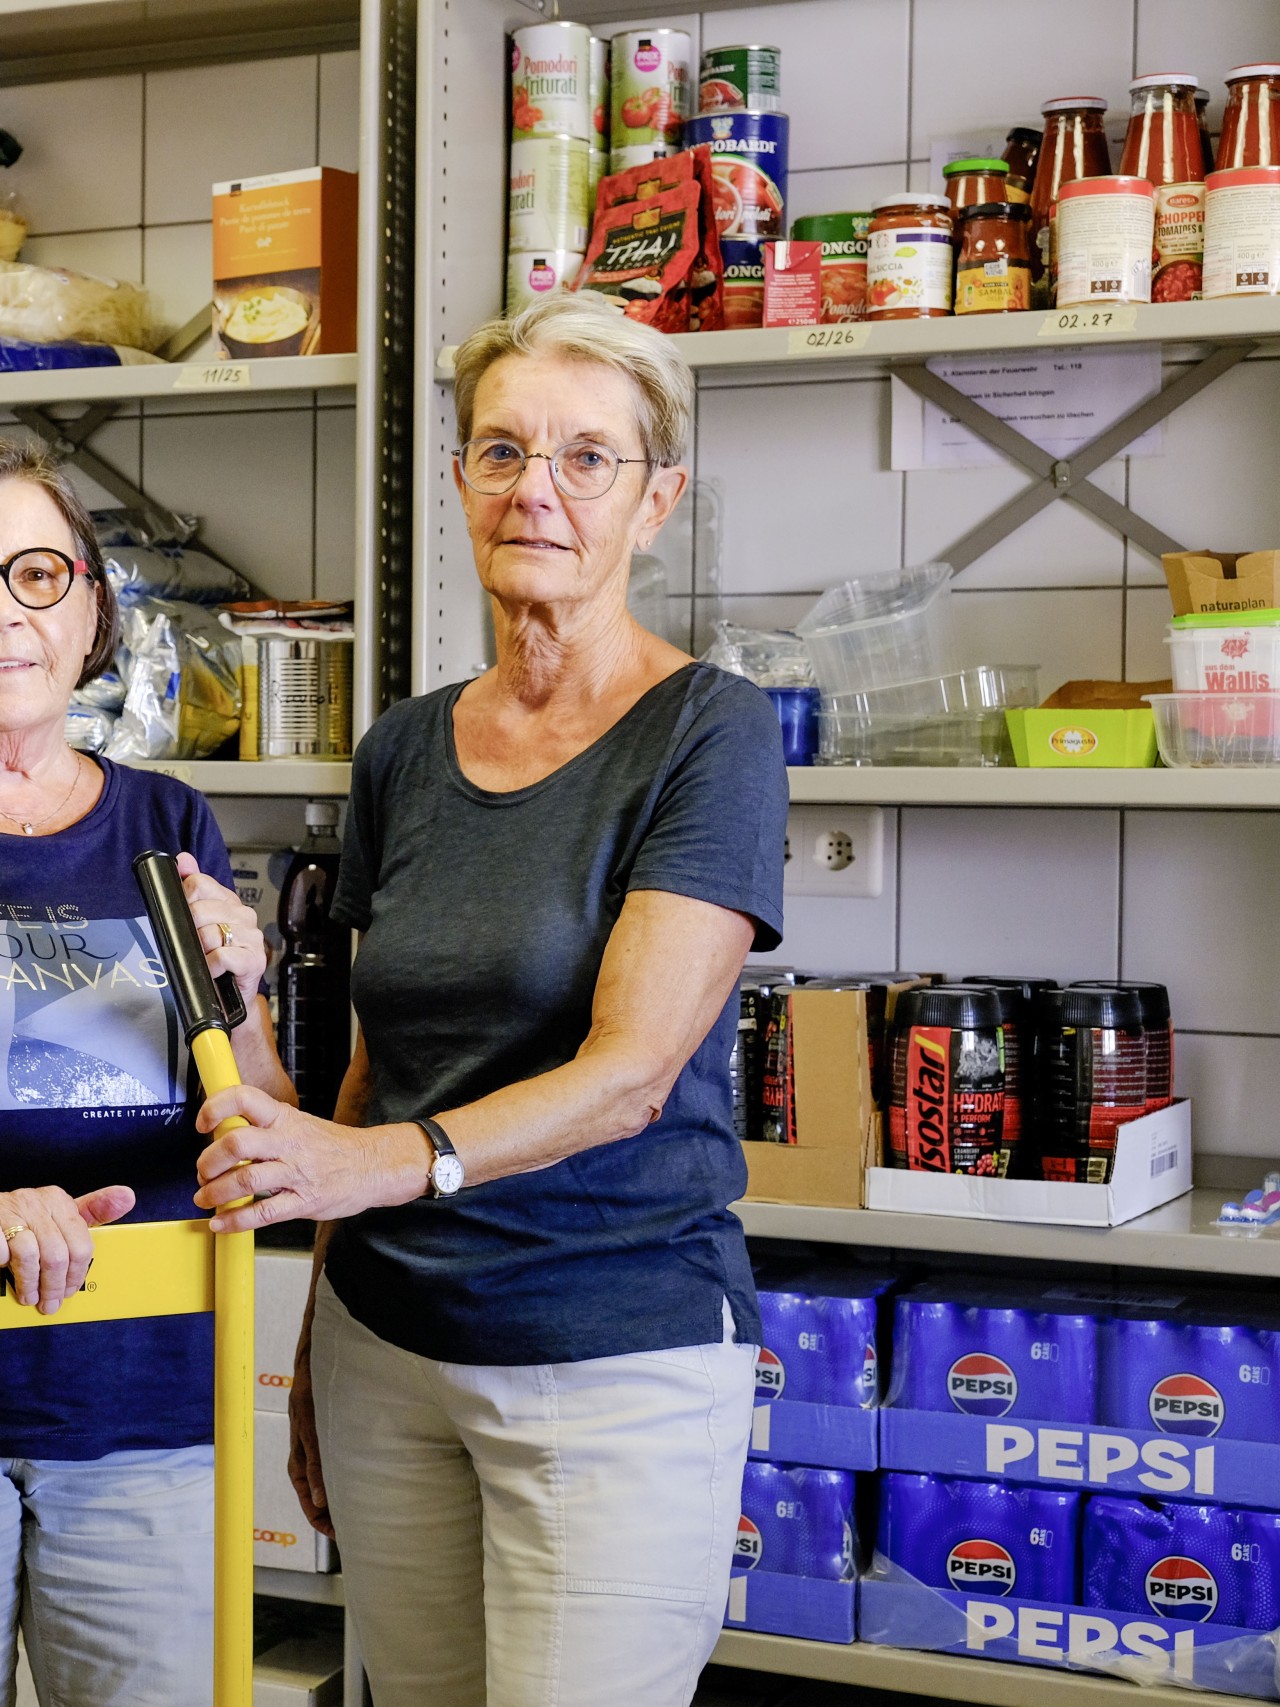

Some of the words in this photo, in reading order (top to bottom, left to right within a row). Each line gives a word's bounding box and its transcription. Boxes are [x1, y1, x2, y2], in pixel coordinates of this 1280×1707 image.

[524, 53, 577, 75] Pomodori
[605, 232, 677, 265] THAI
[806, 330, 854, 348] 02/26
[202, 367, 242, 383] 11/25
[951, 369, 987, 377] Alarmieren
[1001, 366, 1038, 375] Feuerwehr
[992, 390, 1027, 399] Sicherheit
[1028, 389, 1055, 398] bringen
[1019, 413, 1055, 422] versuchen
[1200, 598, 1266, 613] naturaplan
[1220, 663, 1235, 671] dem
[1205, 670, 1270, 691] Wallis
[45, 904, 89, 930] IS
[912, 1034, 946, 1172] isostar
[83, 1110, 122, 1119] CREATE
[141, 1109, 159, 1117] AND
[961, 1114, 991, 1123] PERFORM
[798, 1332, 809, 1350] 6
[1030, 1342, 1041, 1360] 6
[1239, 1364, 1251, 1383] 6
[1252, 1366, 1260, 1384] CANS
[951, 1377, 1013, 1395] PEPSI
[1154, 1397, 1219, 1417] PEPSI
[986, 1423, 1215, 1495] PEPSI
[776, 1501, 787, 1518] 6
[253, 1529, 297, 1547] coop
[1030, 1527, 1040, 1545] 6
[1231, 1543, 1242, 1561] 6
[1242, 1543, 1250, 1561] CANS
[950, 1559, 1012, 1579] PEPSI
[1150, 1581, 1213, 1601] PEPSI
[966, 1600, 1195, 1681] PEPSI
